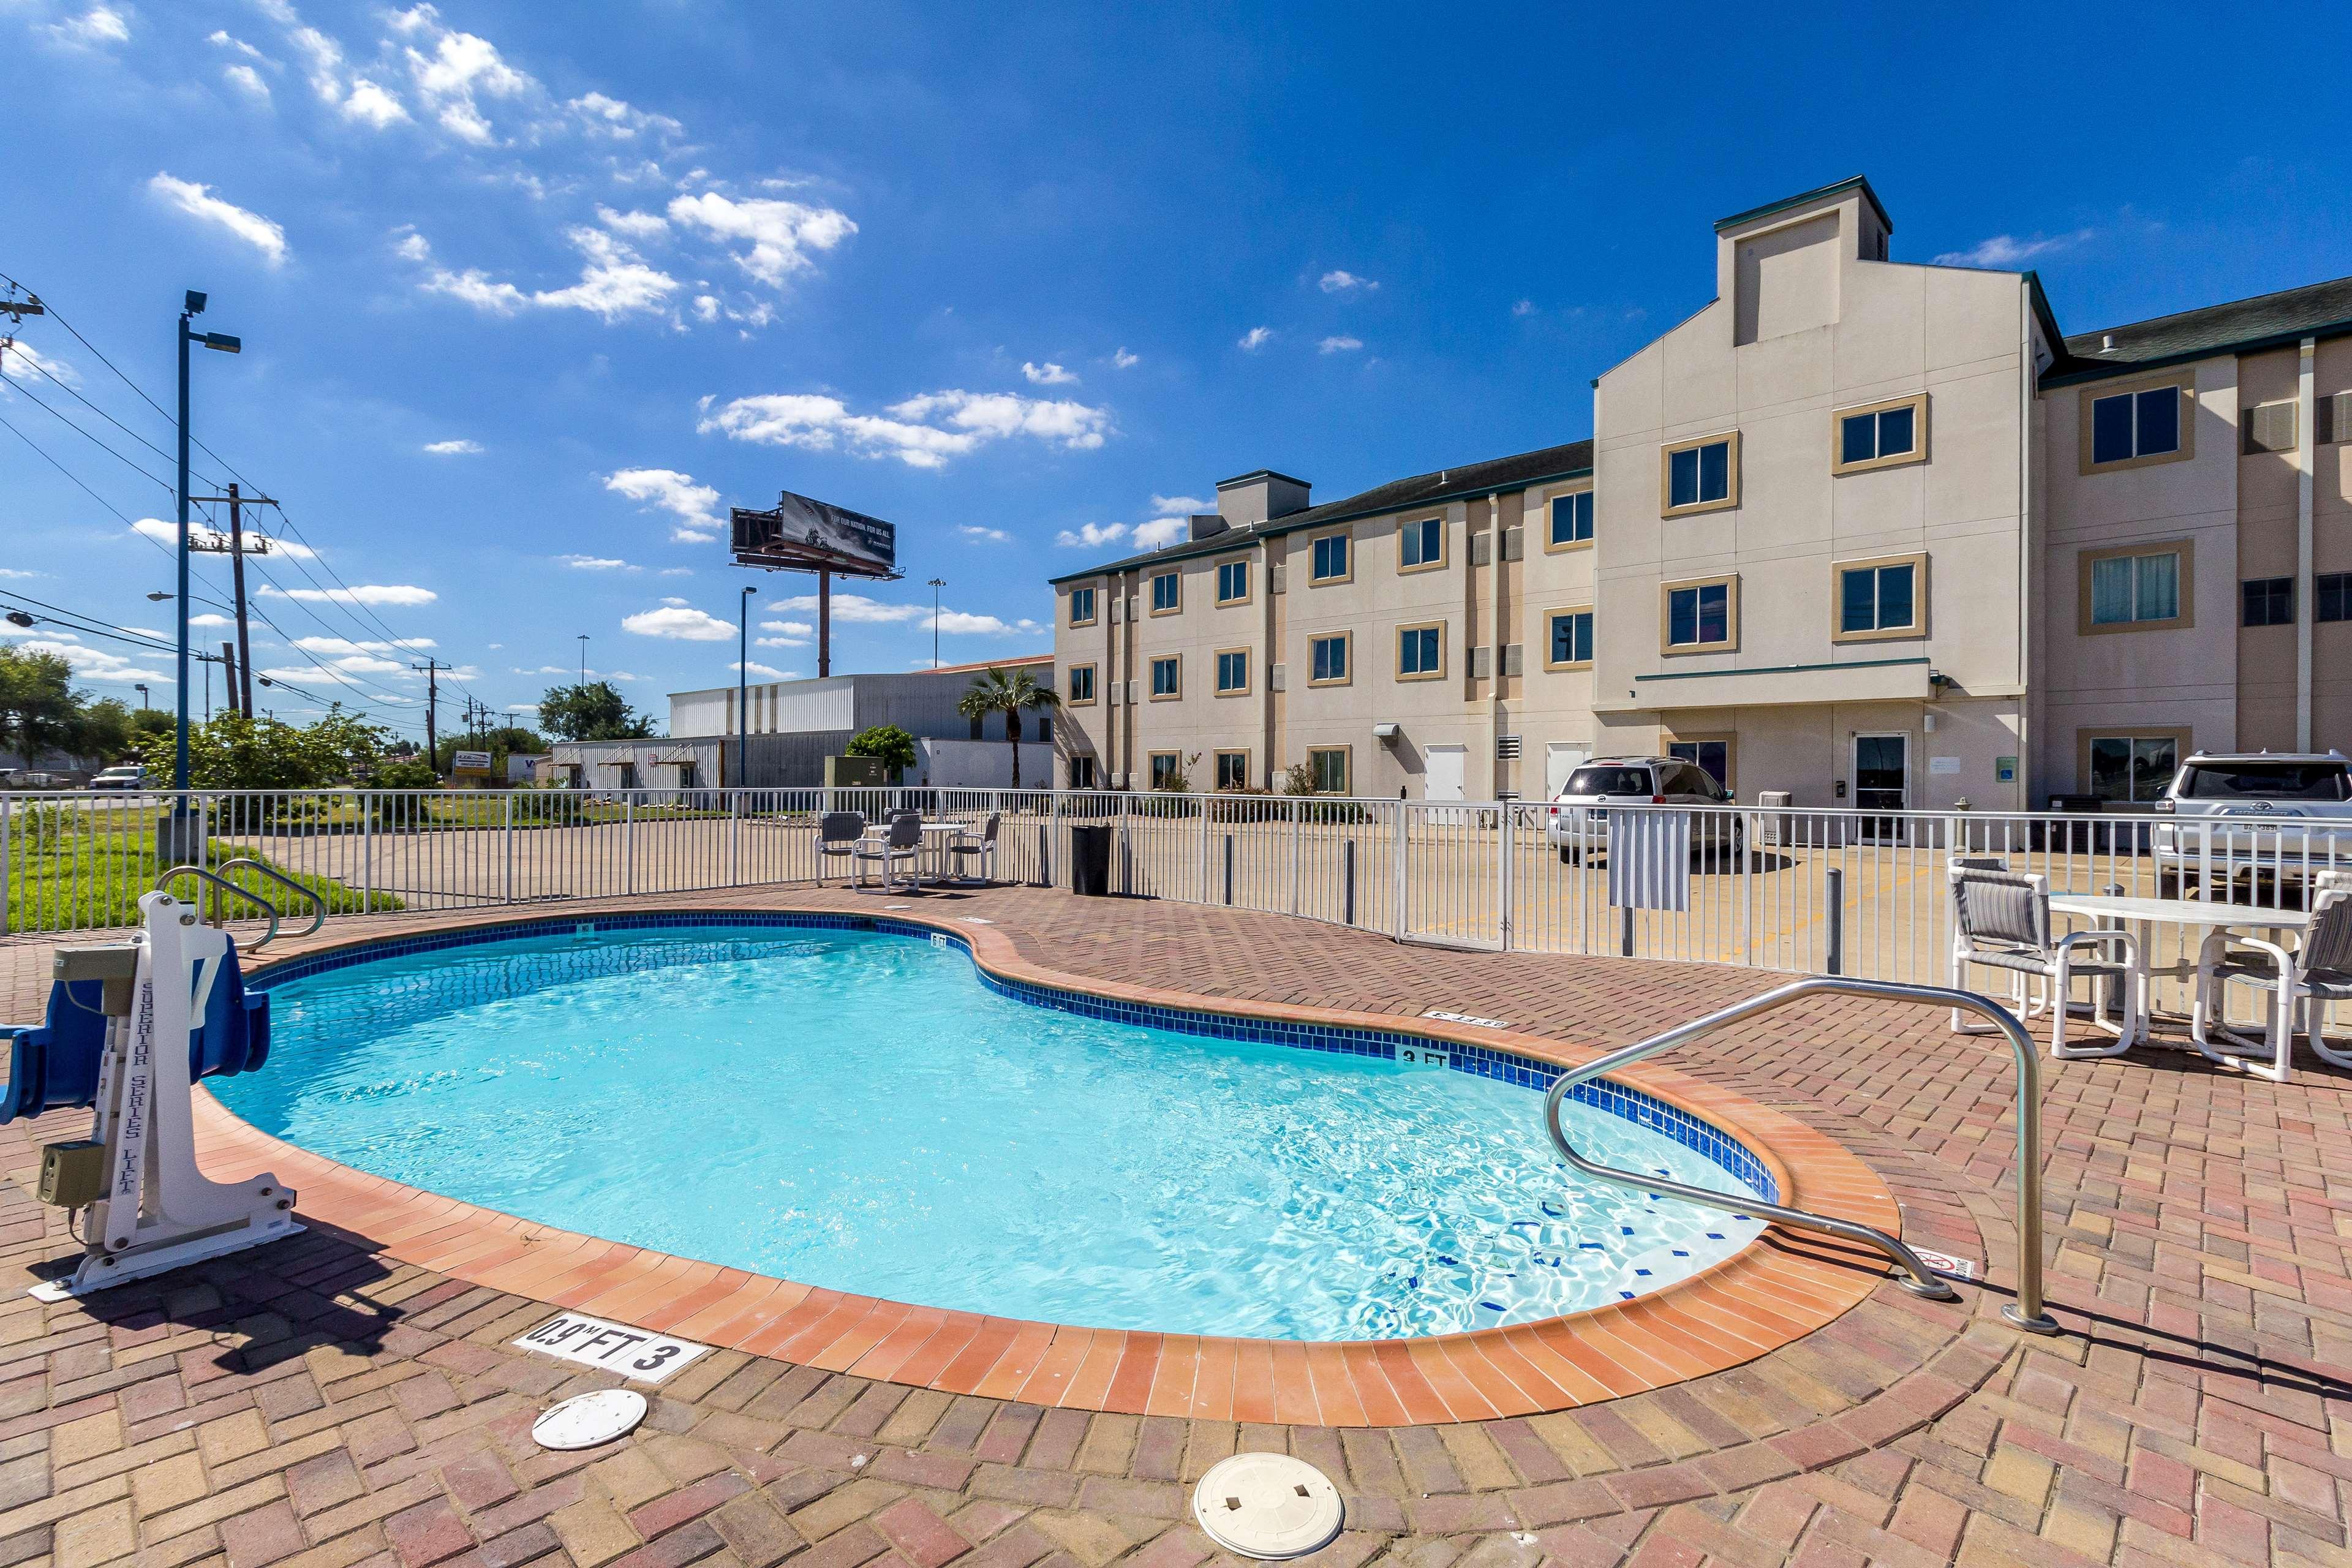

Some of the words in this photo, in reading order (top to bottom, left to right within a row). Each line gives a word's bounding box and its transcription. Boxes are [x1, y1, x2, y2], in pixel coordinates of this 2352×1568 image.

[831, 514, 840, 523] FOR
[840, 518, 850, 526] OUR
[134, 982, 153, 1066] SUPERIOR
[1425, 1052, 1447, 1066] FT
[126, 1075, 146, 1139] SERIES
[119, 1148, 138, 1194] LIFT
[571, 1329, 648, 1359] FT
[633, 1346, 680, 1370] 3
